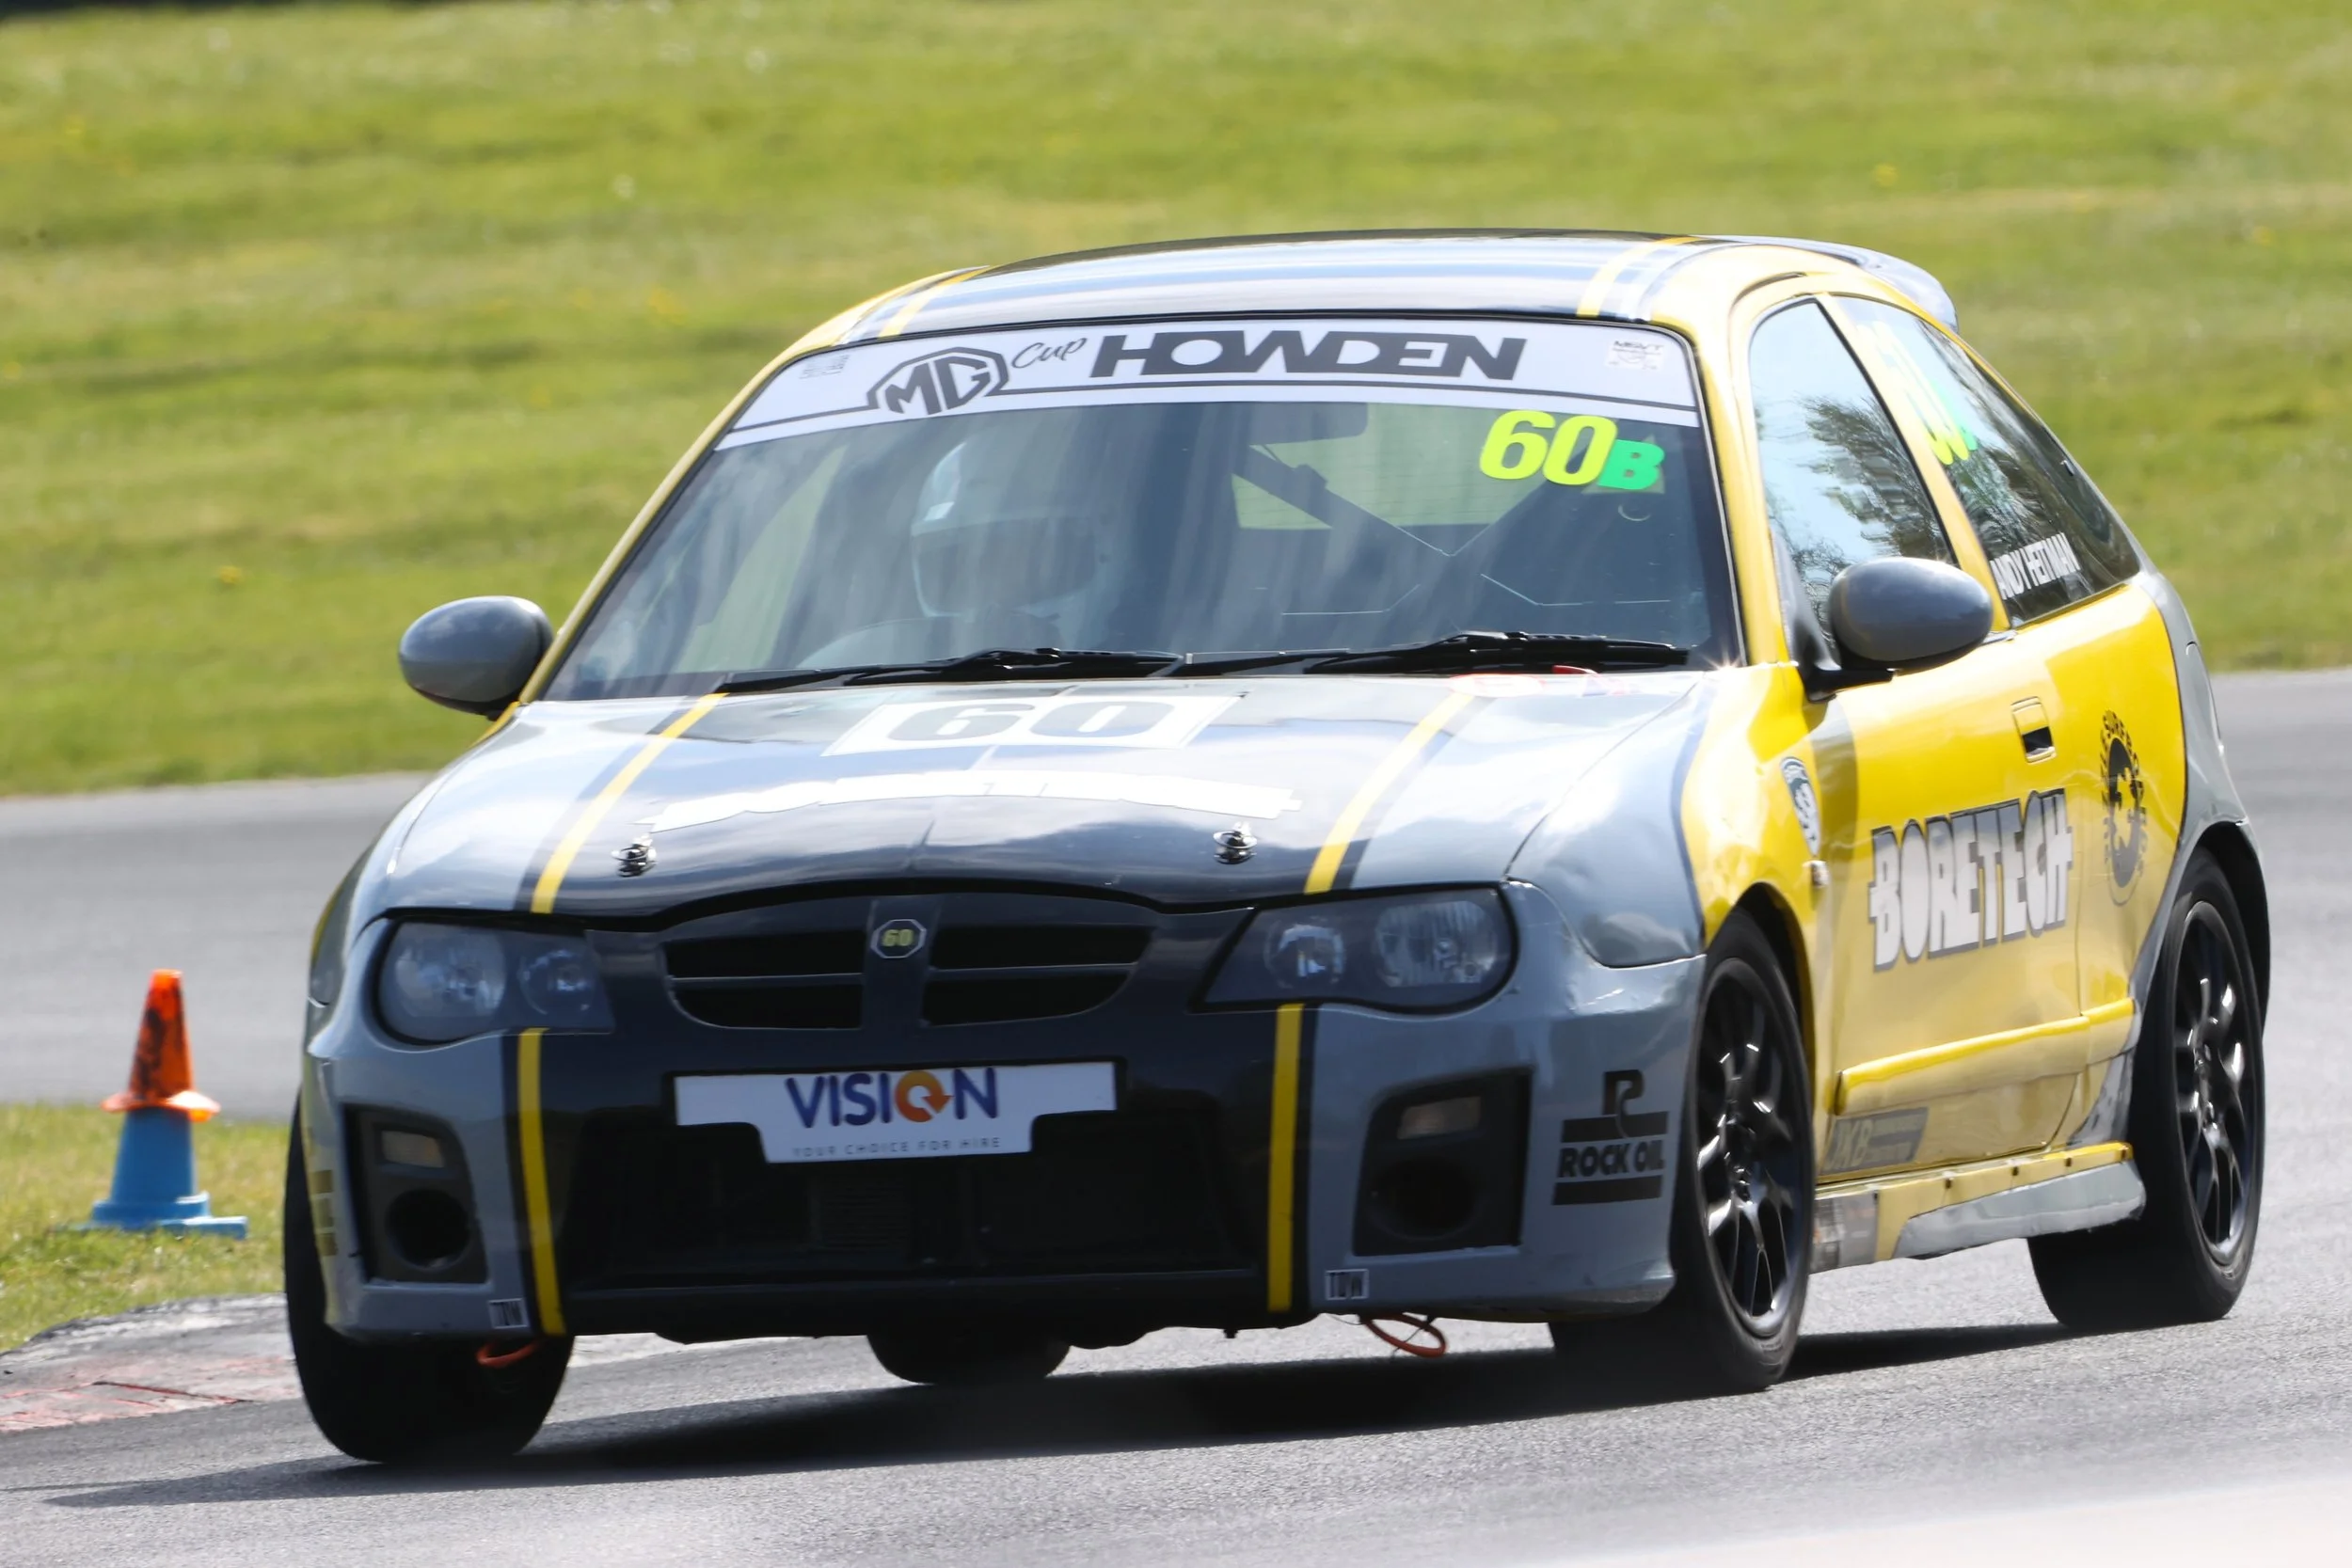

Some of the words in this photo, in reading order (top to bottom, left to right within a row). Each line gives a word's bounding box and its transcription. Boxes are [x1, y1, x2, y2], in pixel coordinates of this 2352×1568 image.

[1012, 338, 1087, 369] Cup
[1089, 330, 1528, 381] HOWDEN
[885, 356, 990, 415] MG
[1989, 548, 2032, 600] ANDY
[886, 701, 1176, 741] 60
[1868, 788, 2073, 973] BORETECH
[882, 928, 914, 947] 60
[785, 1067, 998, 1129] VISION
[792, 1146, 836, 1158] YOUR
[846, 1142, 909, 1155] CHOICE
[917, 1139, 950, 1151] FOR
[960, 1136, 1001, 1149] HIRE
[1557, 1145, 1630, 1178] ROCK
[1634, 1139, 1665, 1173] OIL
